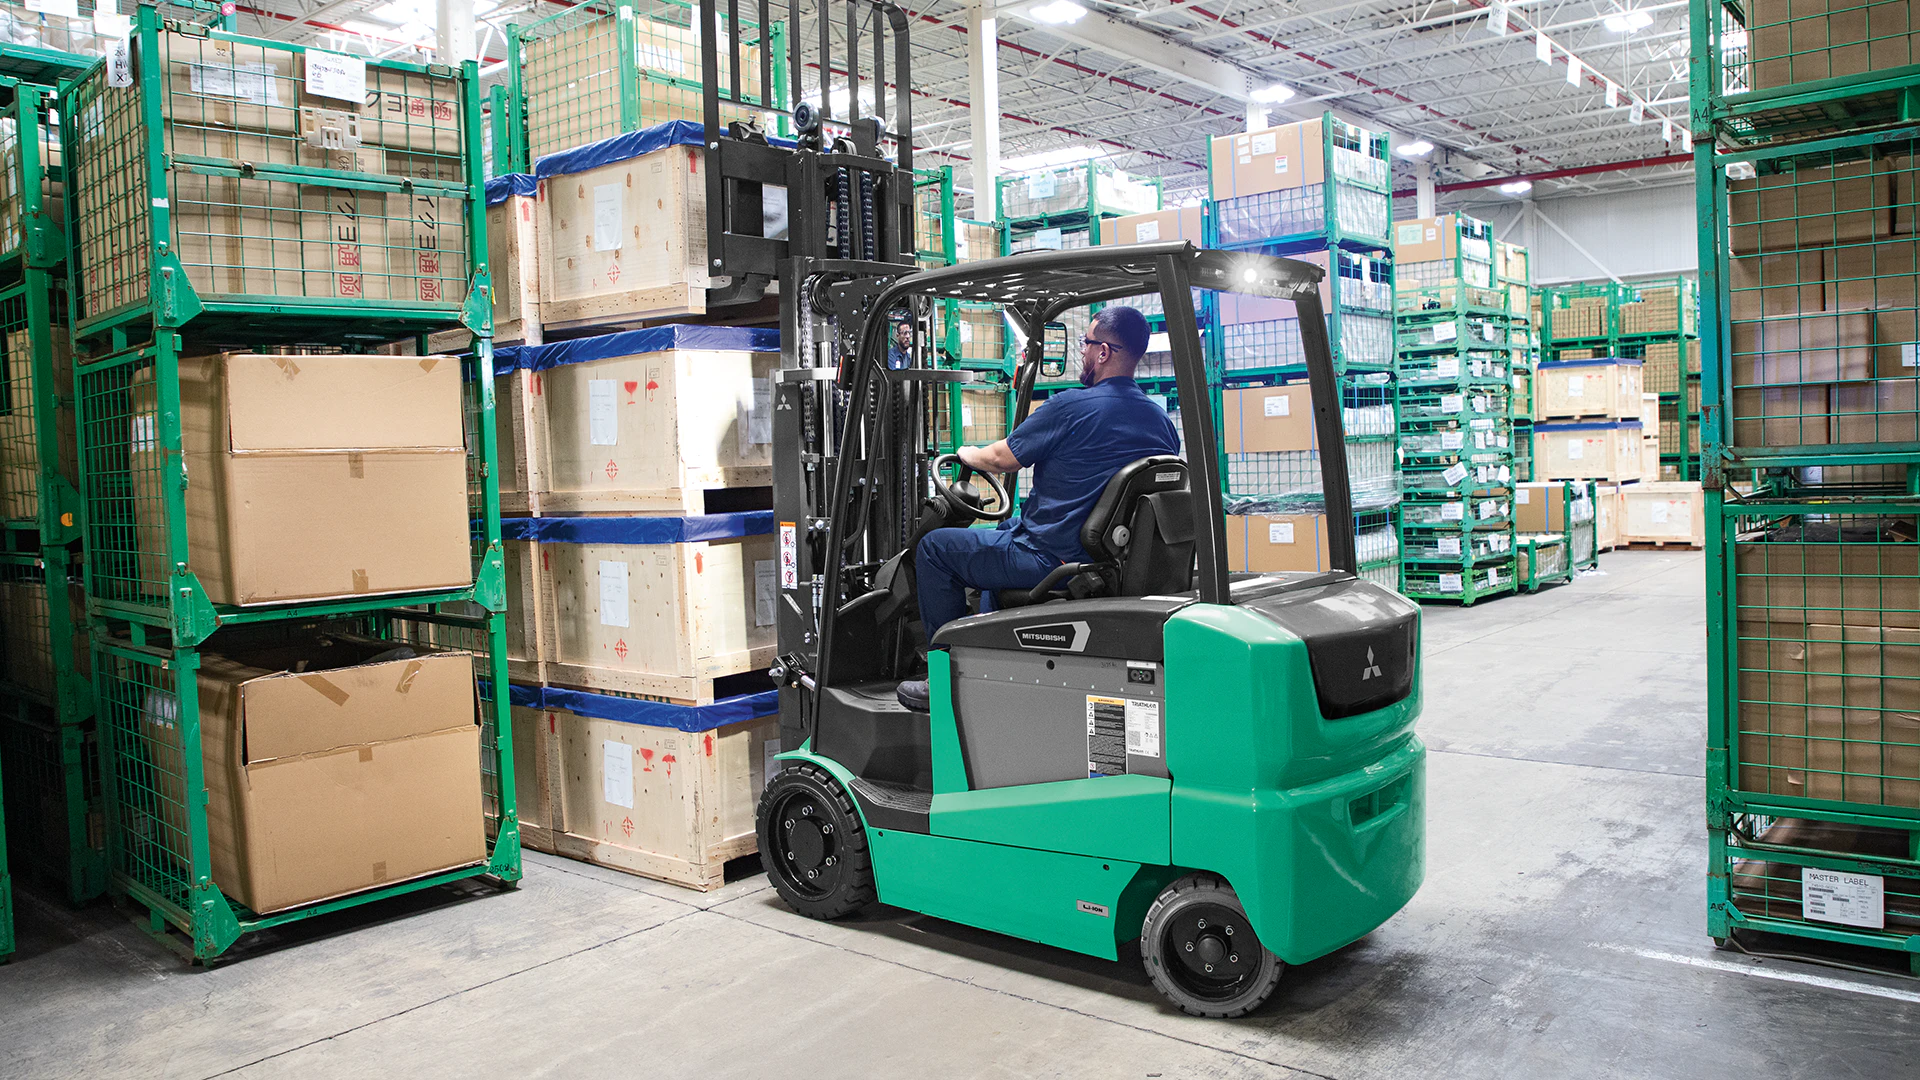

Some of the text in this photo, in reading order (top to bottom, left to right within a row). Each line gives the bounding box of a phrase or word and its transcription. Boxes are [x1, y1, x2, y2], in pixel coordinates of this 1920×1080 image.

[1693, 106, 1709, 124] A4
[270, 305, 281, 314] A4
[286, 610, 298, 618] A4
[1022, 632, 1066, 642] MITSUBISHI
[1809, 873, 1869, 887] MASTER LABEL
